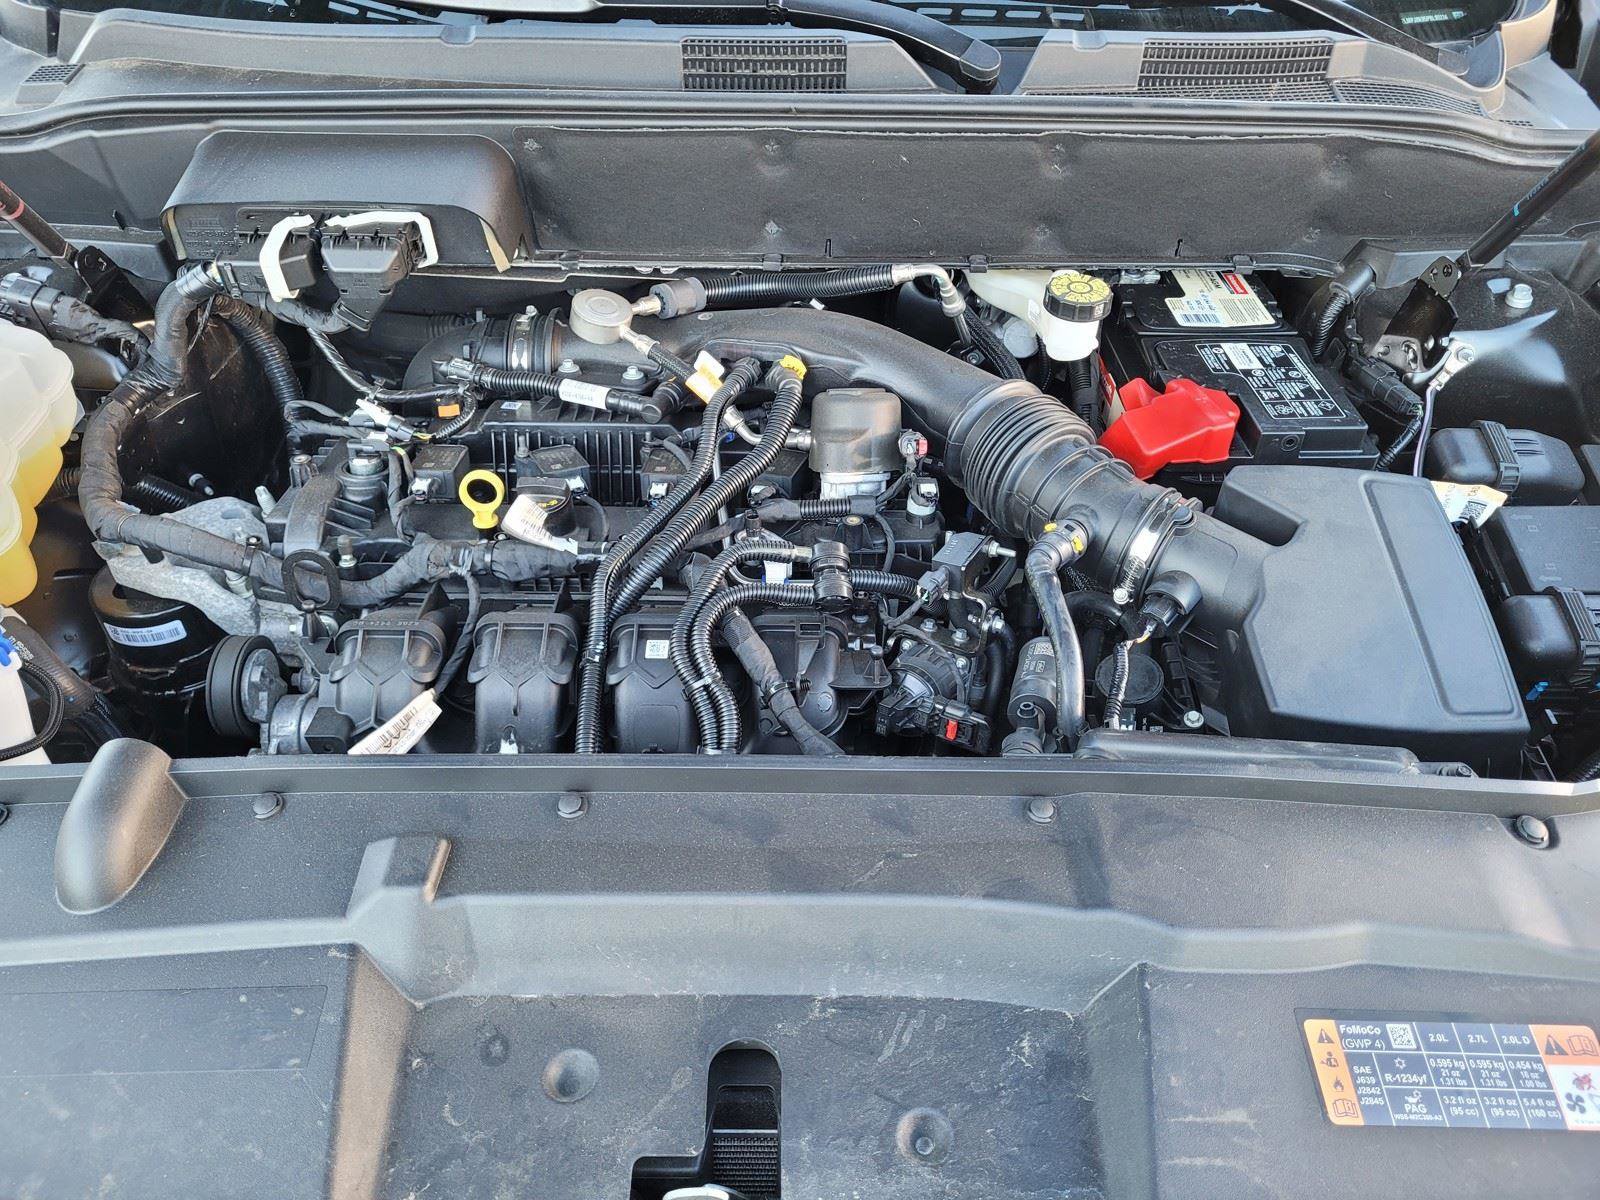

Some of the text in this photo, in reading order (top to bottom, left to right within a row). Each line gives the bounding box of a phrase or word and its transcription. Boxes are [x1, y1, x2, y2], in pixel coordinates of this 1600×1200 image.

[1340, 1025, 1381, 1034] FoMoCo
[1428, 1033, 1449, 1042] 2.0L
[1467, 1034, 1488, 1043] 2.7L
[1501, 1035, 1522, 1044] 2.0L
[1342, 1038, 1386, 1050] (GWP 4)
[1429, 1058, 1466, 1070] 0.595 kg
[1469, 1059, 1505, 1071] 0.595 kg
[1508, 1060, 1544, 1072] 0.454 kg
[1352, 1065, 1373, 1074] SAE
[1440, 1069, 1449, 1077] 21
[1480, 1069, 1490, 1078] 21
[1356, 1075, 1376, 1084] J639
[1384, 1073, 1427, 1085] R-1234yf
[1442, 1096, 1457, 1104] 3.2
[1465, 1097, 1477, 1105] oz
[1483, 1096, 1497, 1105] 3.2
[1505, 1098, 1518, 1106] oz
[1404, 1103, 1427, 1114] PAG
